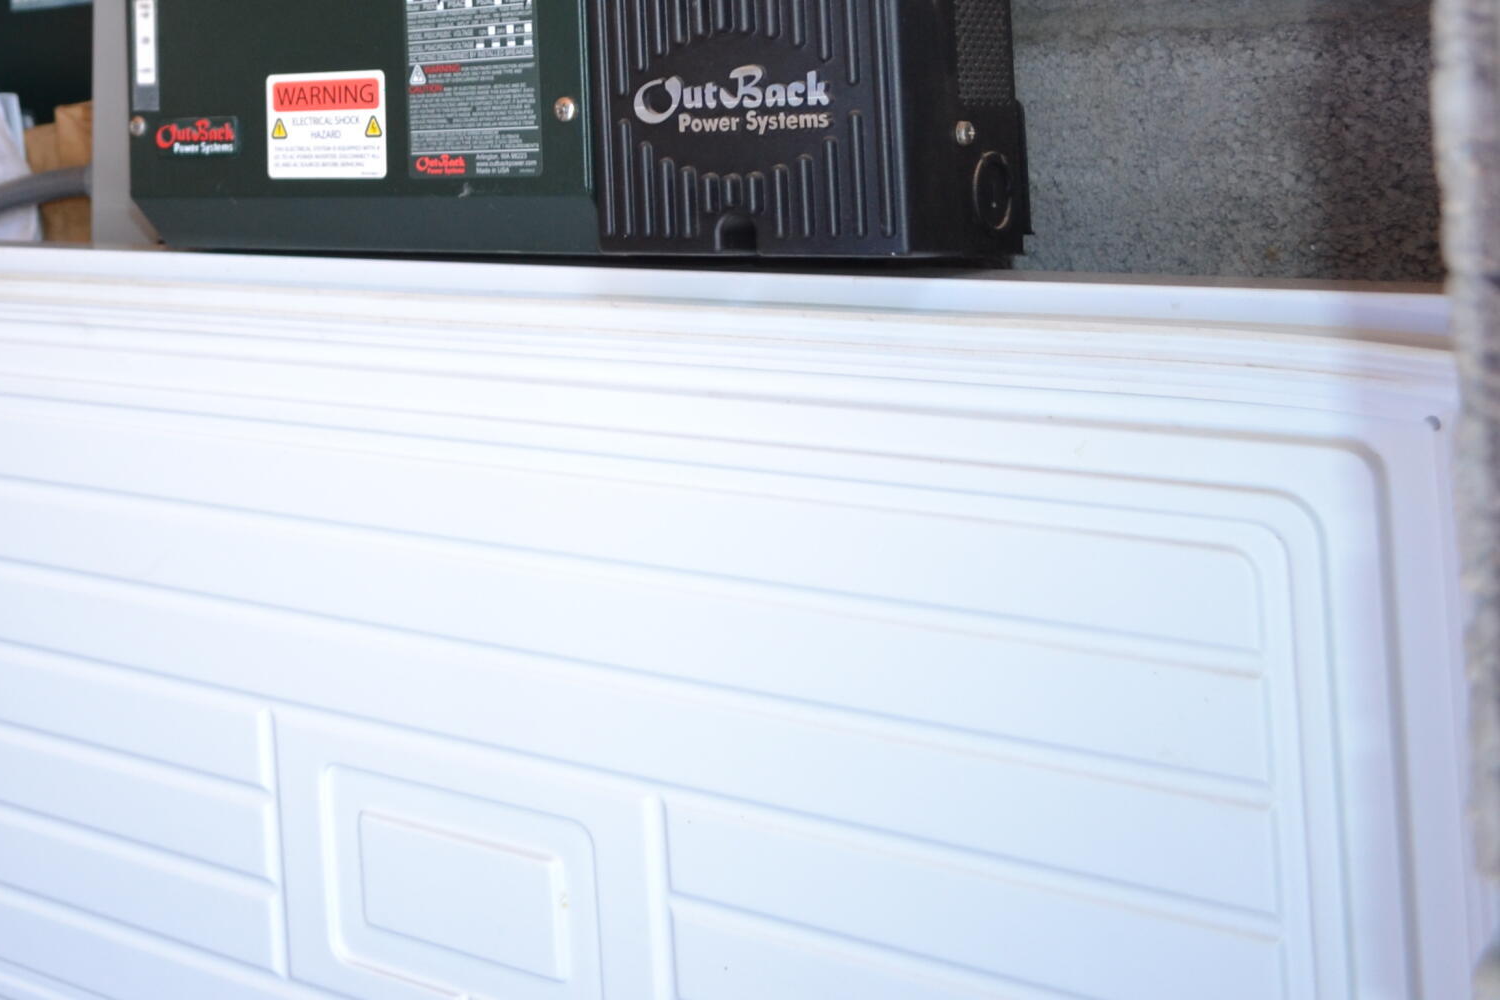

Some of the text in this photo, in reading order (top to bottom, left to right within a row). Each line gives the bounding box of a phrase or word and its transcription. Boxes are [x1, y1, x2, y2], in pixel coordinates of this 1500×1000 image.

[277, 84, 374, 106] WARNING
[633, 64, 830, 124] OutBack
[292, 115, 359, 126] ELECTRICAL SHOCK
[678, 111, 830, 135] Power Systems
[155, 118, 235, 149] OutBack
[310, 129, 341, 139] HAZARD
[173, 141, 234, 155] Power Systems
[416, 153, 466, 172] OutBack
[497, 166, 510, 174] USA
